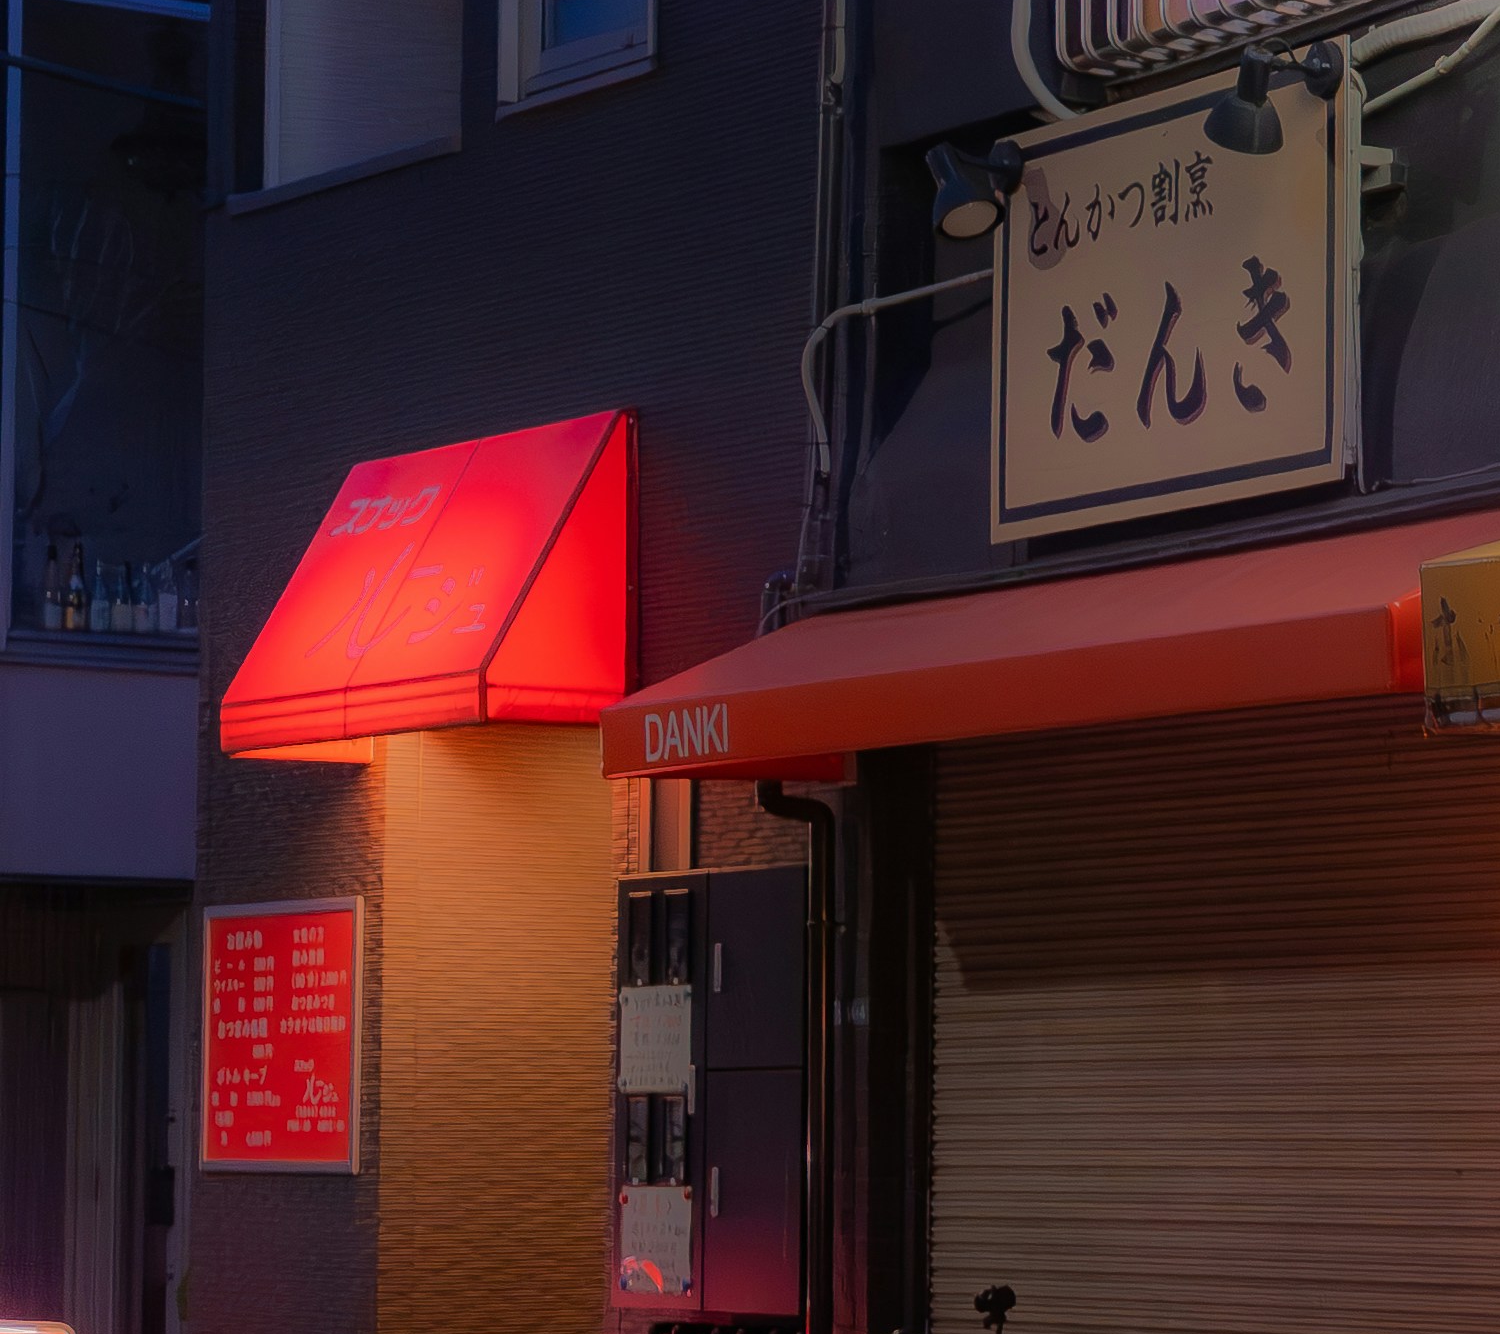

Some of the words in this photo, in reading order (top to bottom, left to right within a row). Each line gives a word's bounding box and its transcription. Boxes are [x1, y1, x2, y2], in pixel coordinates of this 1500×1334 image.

[1028, 150, 1214, 255] とんかつ割烹
[1046, 255, 1292, 444] だんき
[329, 484, 442, 538] スナック
[644, 703, 730, 763] DANKI
